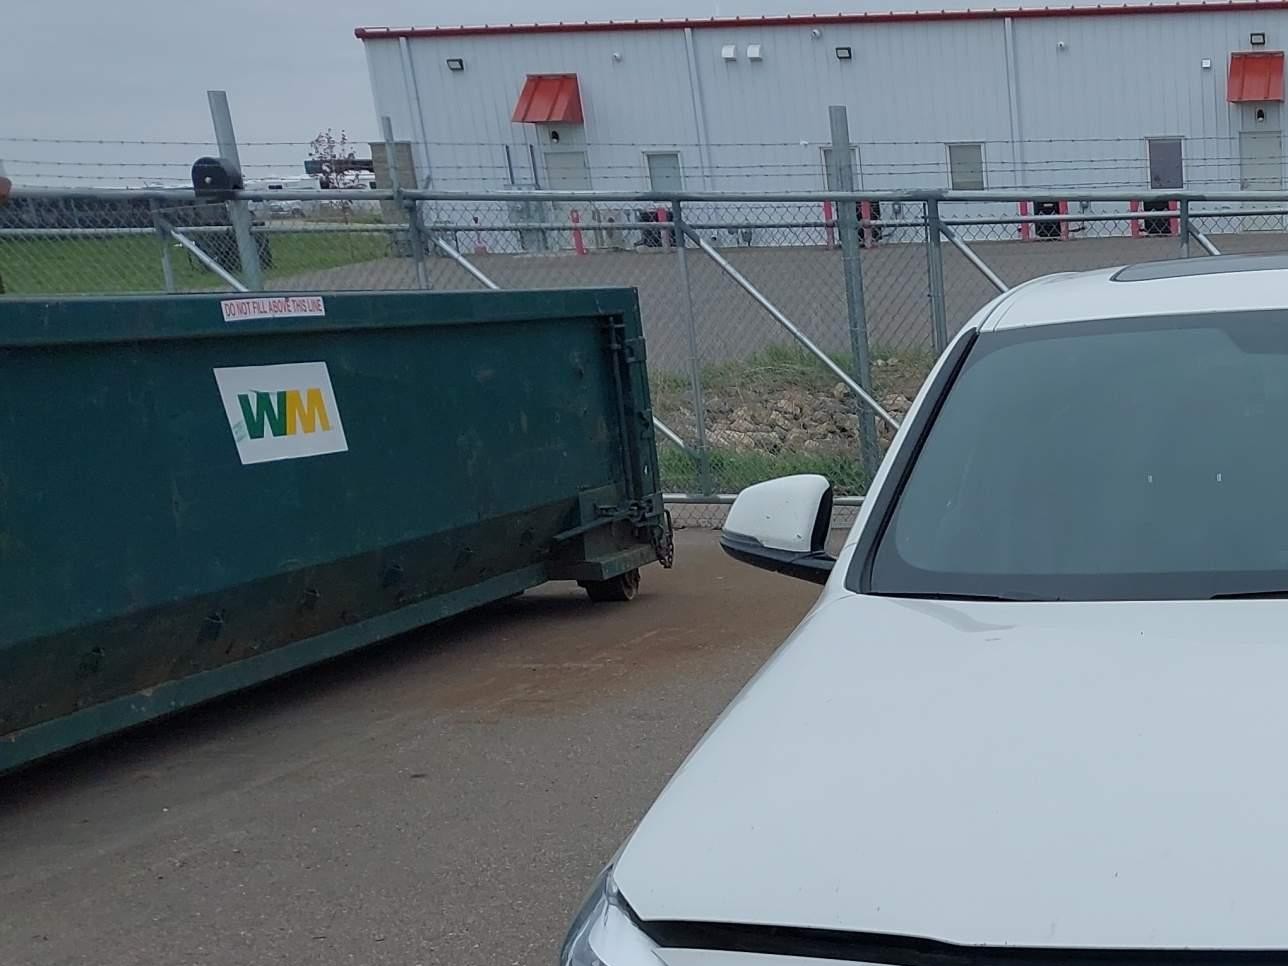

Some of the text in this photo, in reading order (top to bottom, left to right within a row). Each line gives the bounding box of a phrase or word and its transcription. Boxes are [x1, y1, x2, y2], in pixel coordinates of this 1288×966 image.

[224, 299, 322, 317] DO NOT FILL ABOVE THIS LINE
[237, 387, 331, 440] WM
